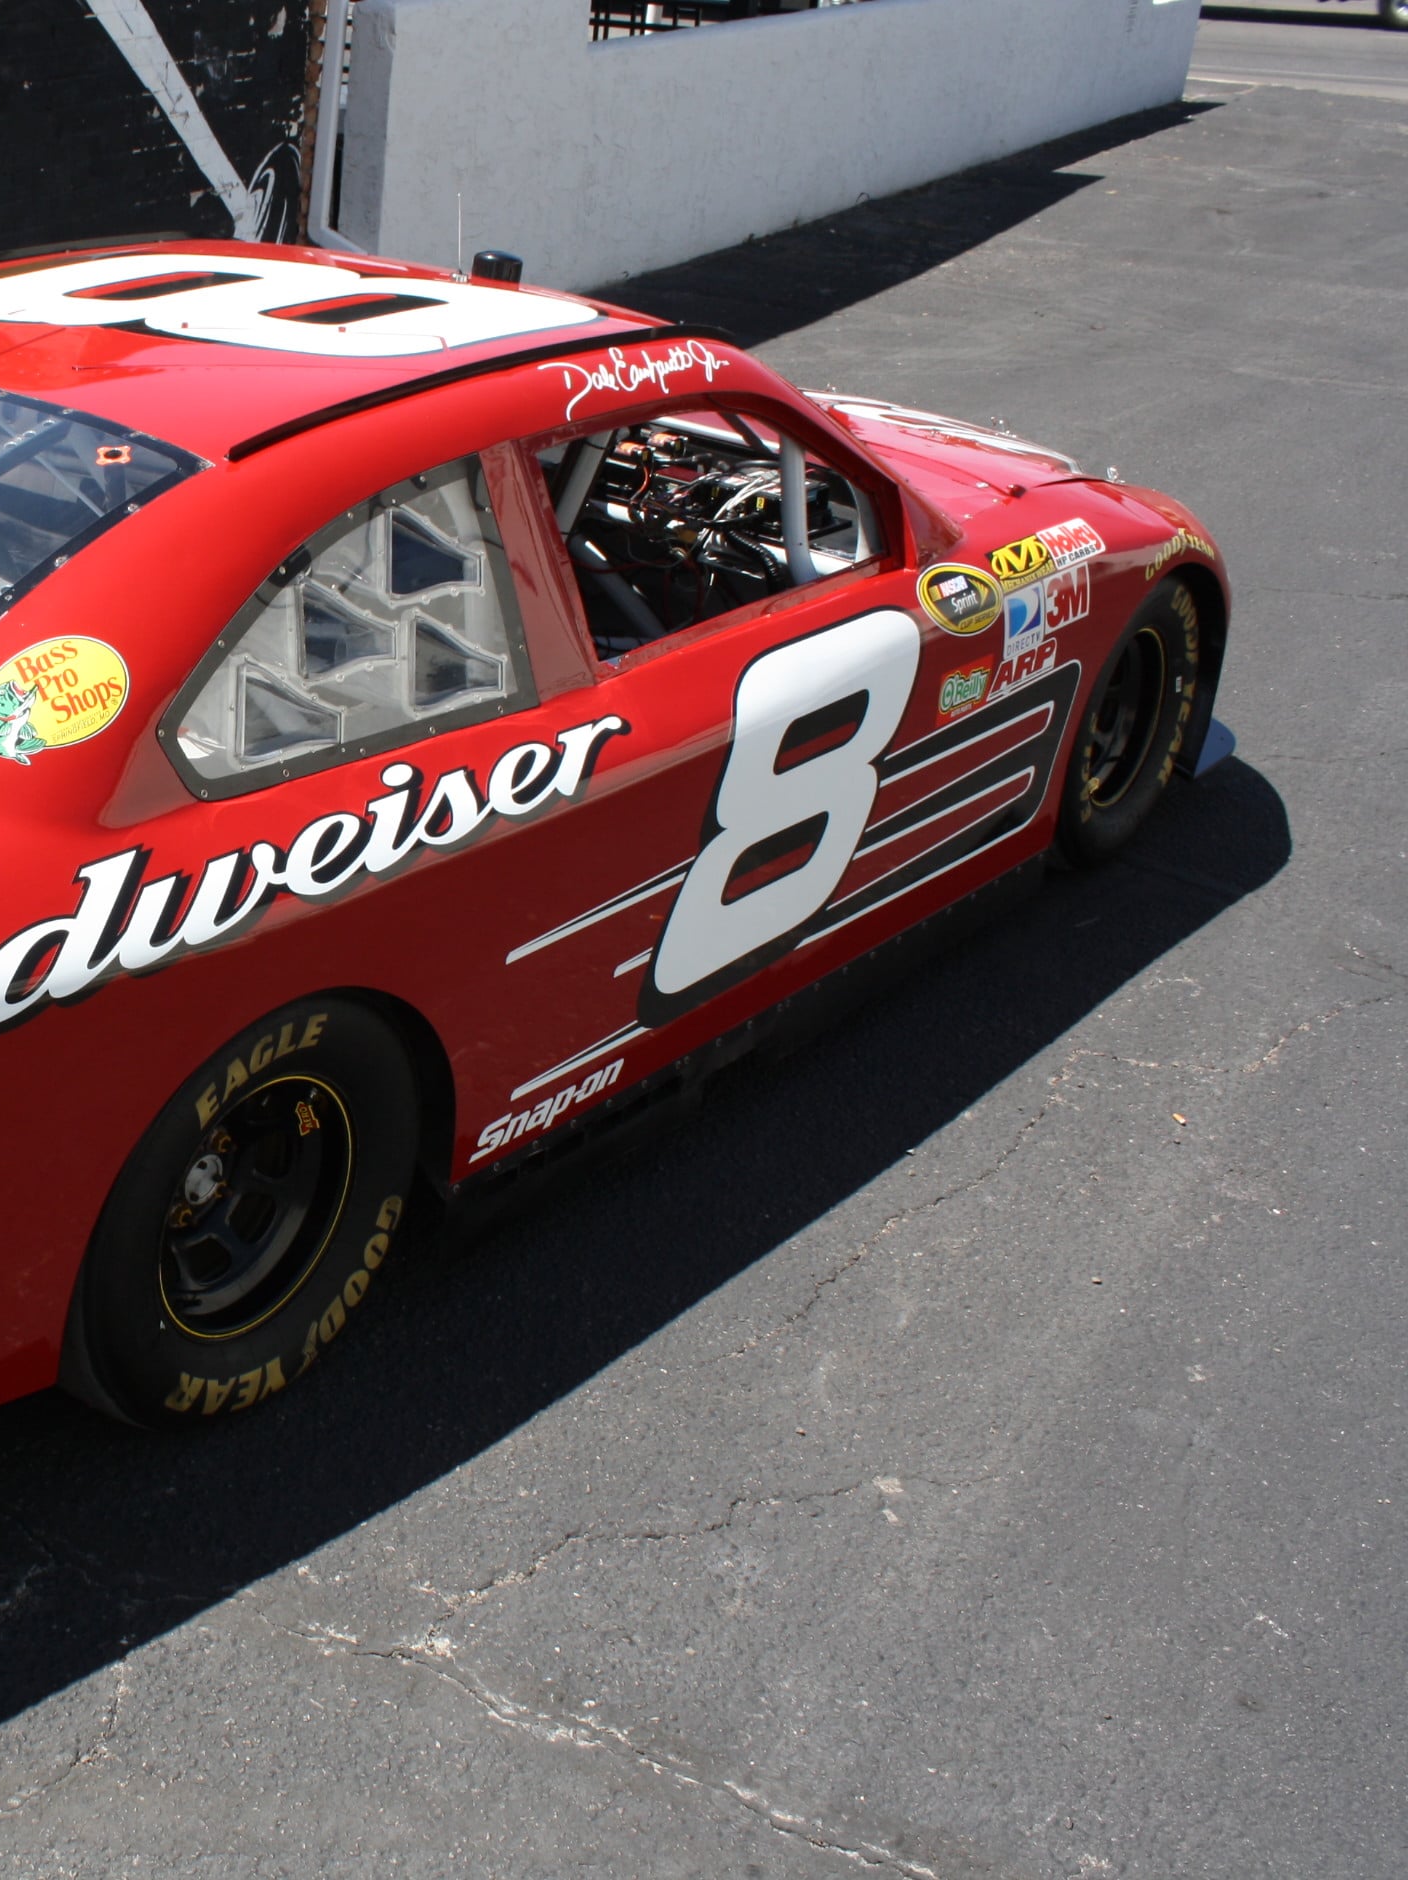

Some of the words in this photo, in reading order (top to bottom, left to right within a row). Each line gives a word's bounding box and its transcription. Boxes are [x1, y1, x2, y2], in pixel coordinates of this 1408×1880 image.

[537, 361, 619, 421] Dale
[1039, 524, 1102, 557] Holley
[1056, 556, 1067, 567] HP
[1068, 544, 1097, 562] CARBS
[951, 589, 979, 615] Sprint
[1046, 564, 1088, 628] 3M
[14, 641, 78, 684] Bass
[994, 642, 1056, 687] ARP
[1006, 631, 1041, 657] DIRECTV
[33, 667, 79, 702] Pro
[50, 677, 123, 724] Shops
[941, 671, 988, 710] O'Reilly
[653, 609, 922, 995] 8
[194, 1012, 329, 1131] EAGLE
[468, 1057, 625, 1164] Snap-on
